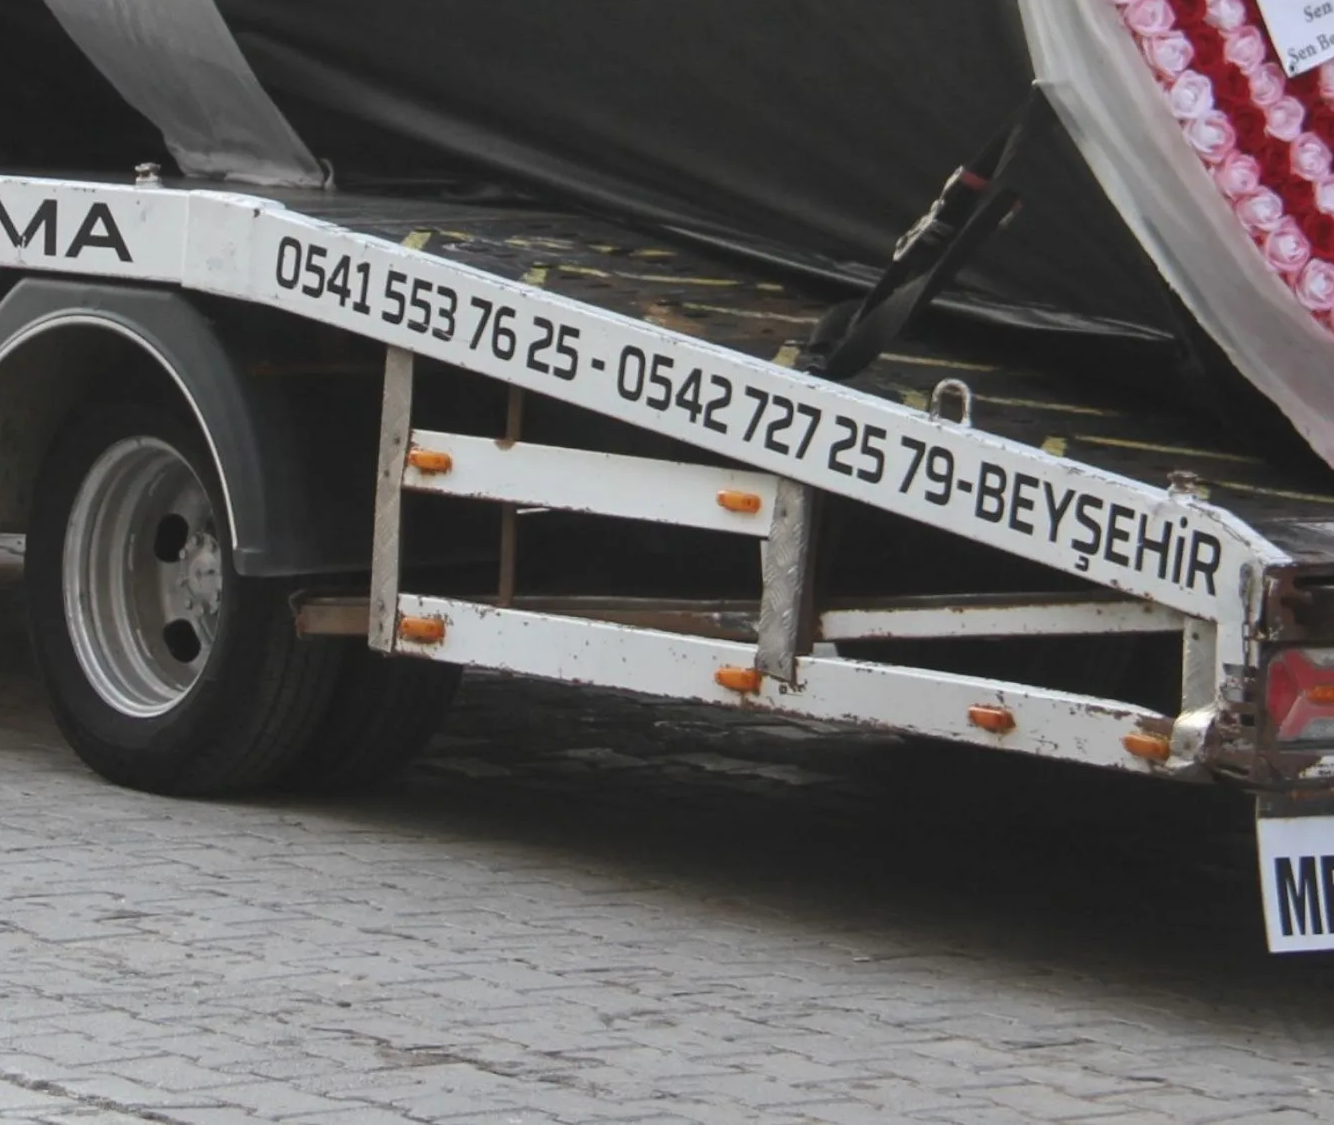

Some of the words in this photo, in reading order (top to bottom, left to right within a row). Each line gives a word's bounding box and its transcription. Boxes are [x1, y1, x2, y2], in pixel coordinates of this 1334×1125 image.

[1303, 0, 1333, 23] Sen
[275, 236, 372, 316] 0541
[380, 270, 458, 342] 553
[467, 296, 517, 361] 76
[526, 315, 581, 382] 25
[616, 345, 734, 435] 0542
[742, 386, 822, 461] 727
[827, 415, 887, 485] 25
